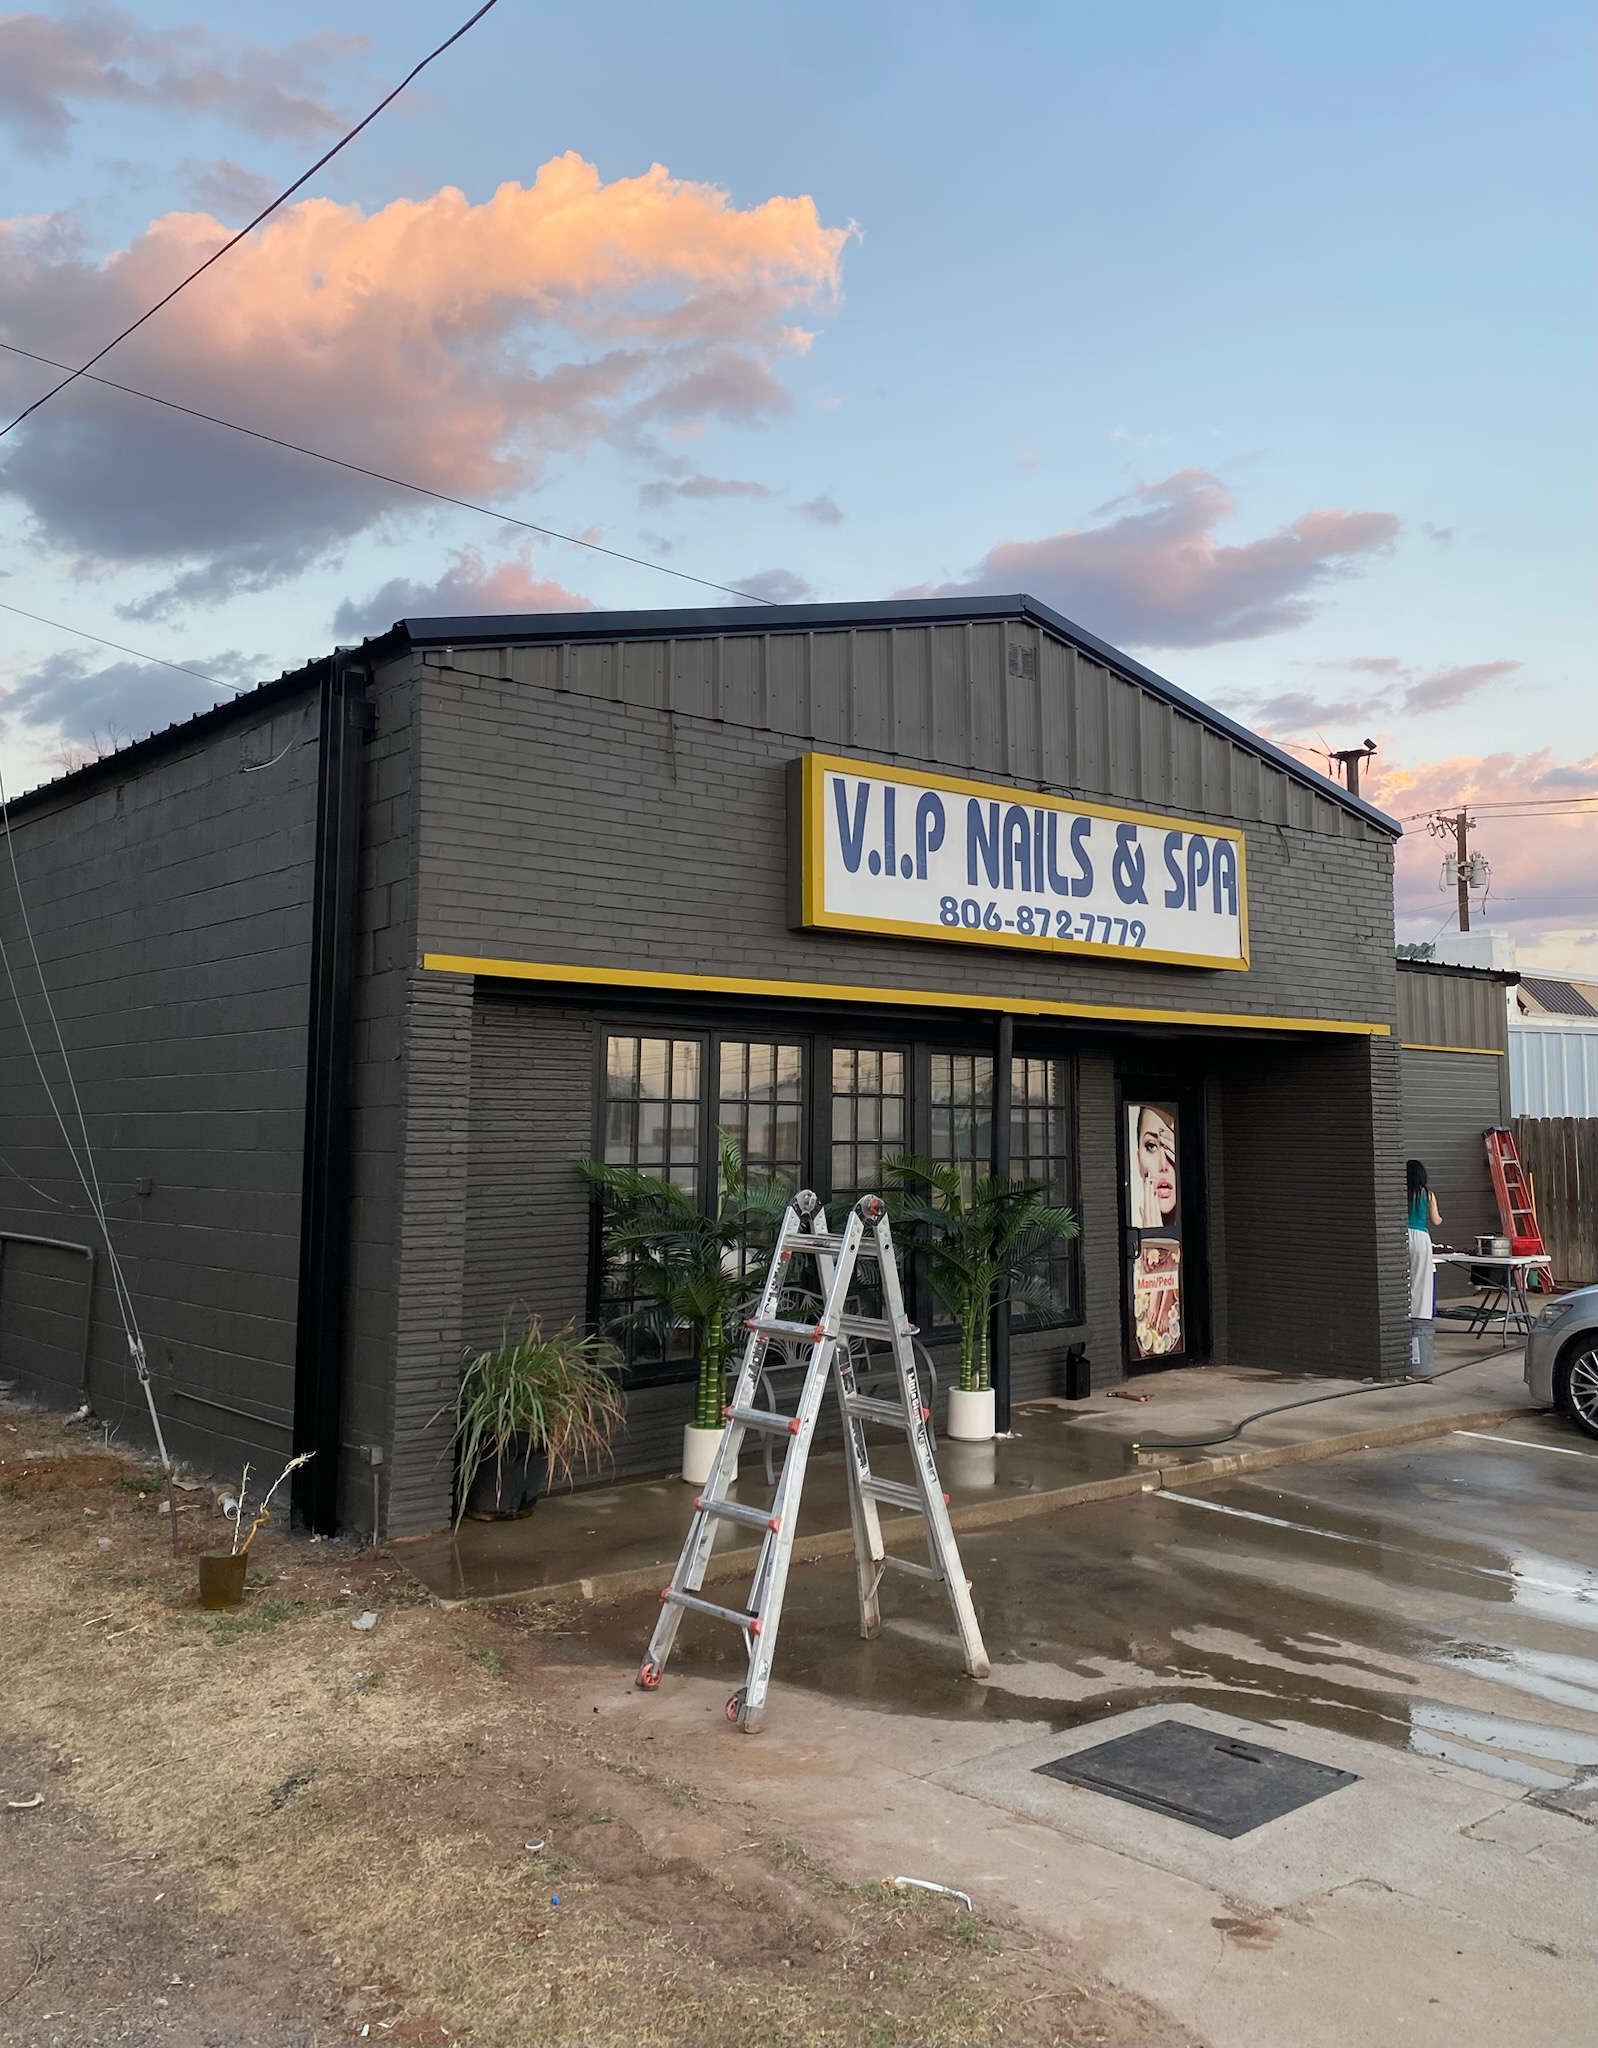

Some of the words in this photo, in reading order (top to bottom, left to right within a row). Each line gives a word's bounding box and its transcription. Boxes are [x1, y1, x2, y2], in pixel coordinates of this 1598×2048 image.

[832, 777, 946, 881] V.I.P
[966, 798, 1094, 898] NAILS
[1111, 823, 1149, 905] &
[1164, 830, 1238, 916] SPA
[939, 895, 1146, 948] 806-872-7779
[1137, 1275, 1175, 1290] Mani/Pedi
